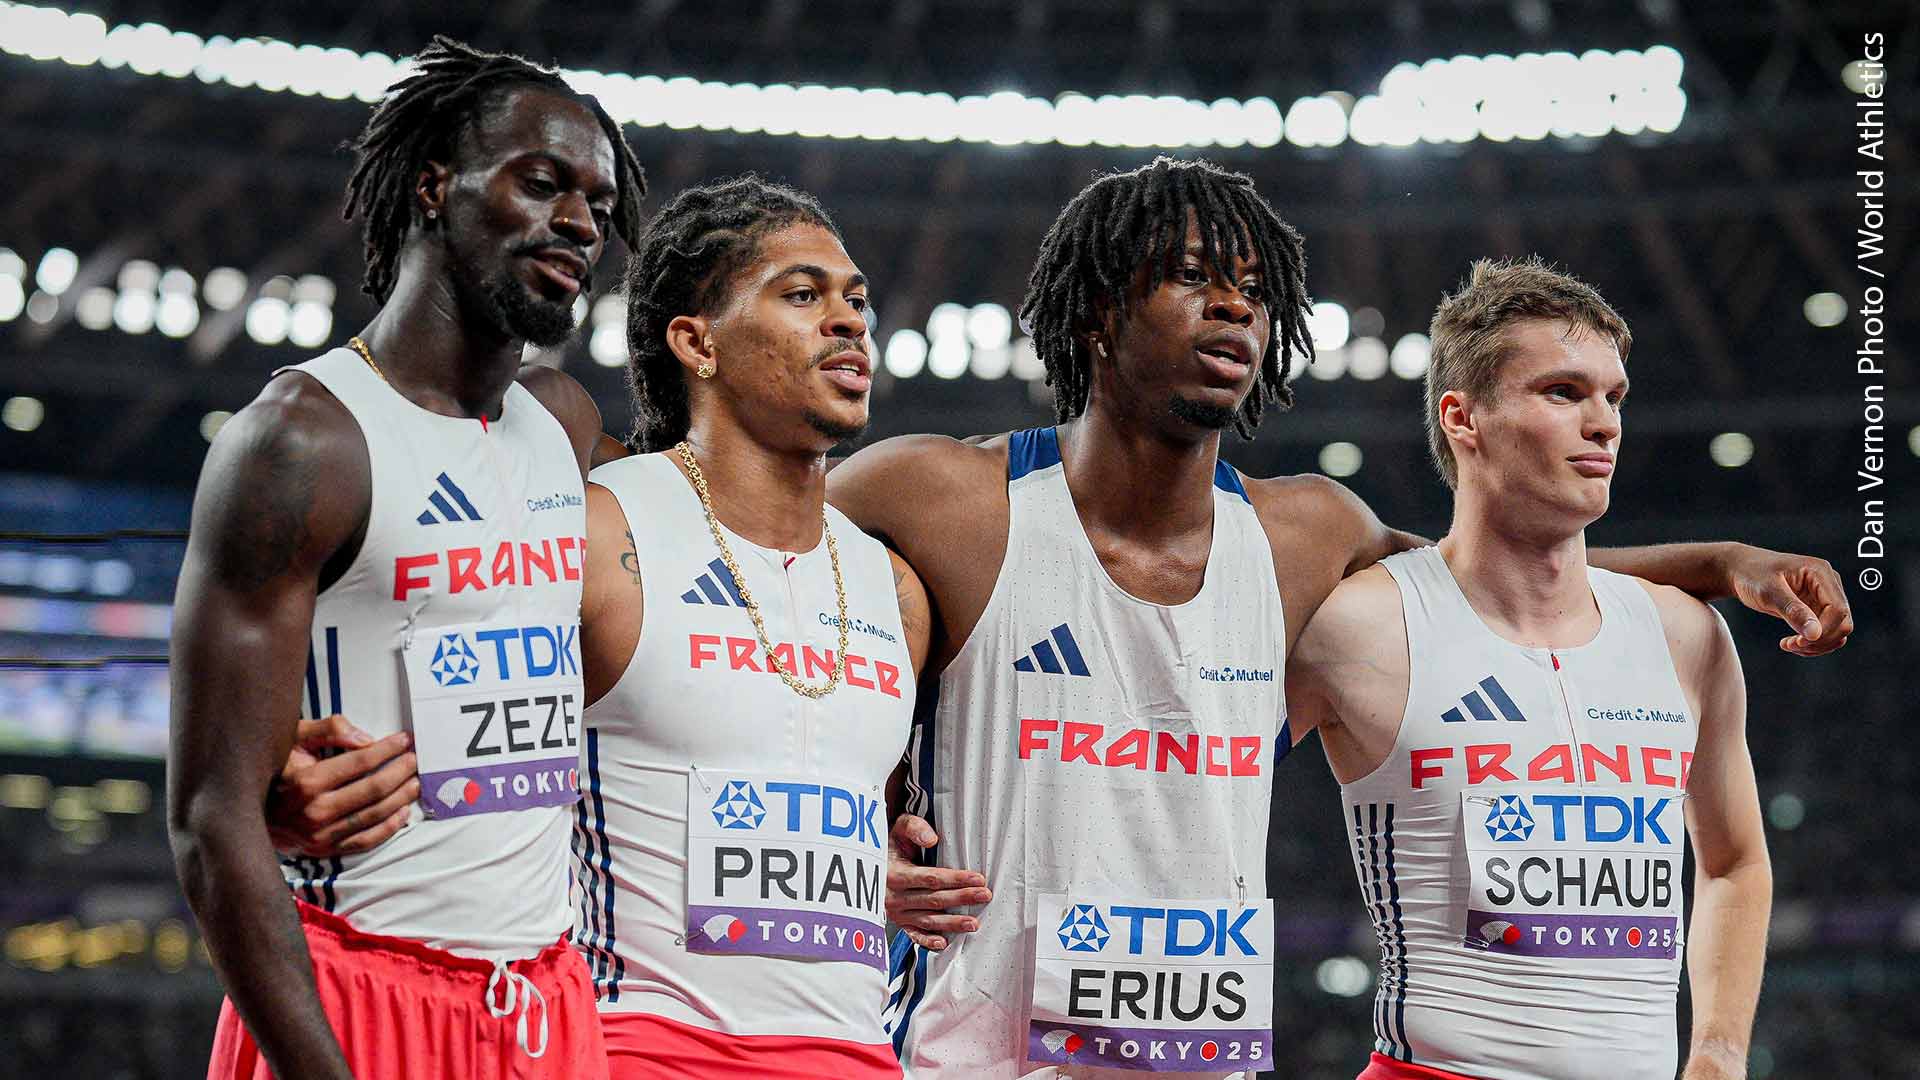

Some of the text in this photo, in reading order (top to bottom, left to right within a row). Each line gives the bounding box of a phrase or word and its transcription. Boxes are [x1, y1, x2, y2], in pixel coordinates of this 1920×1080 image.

[393, 537, 587, 602] FRANC
[818, 612, 855, 631] Créit
[476, 624, 578, 681] TDK
[689, 634, 902, 699] FRANCE
[1236, 668, 1273, 682] Mutuel
[461, 694, 577, 758] ZEZE
[1587, 707, 1686, 724] Crédit Mutuel
[1018, 718, 1262, 777] FRANCE
[766, 781, 881, 849] TDK
[1533, 795, 1672, 844] TDK
[714, 846, 880, 915] PRIAM
[1485, 857, 1672, 908] SCHAUB
[1110, 905, 1259, 956] TDK
[1068, 968, 1247, 1022] ERIUS
